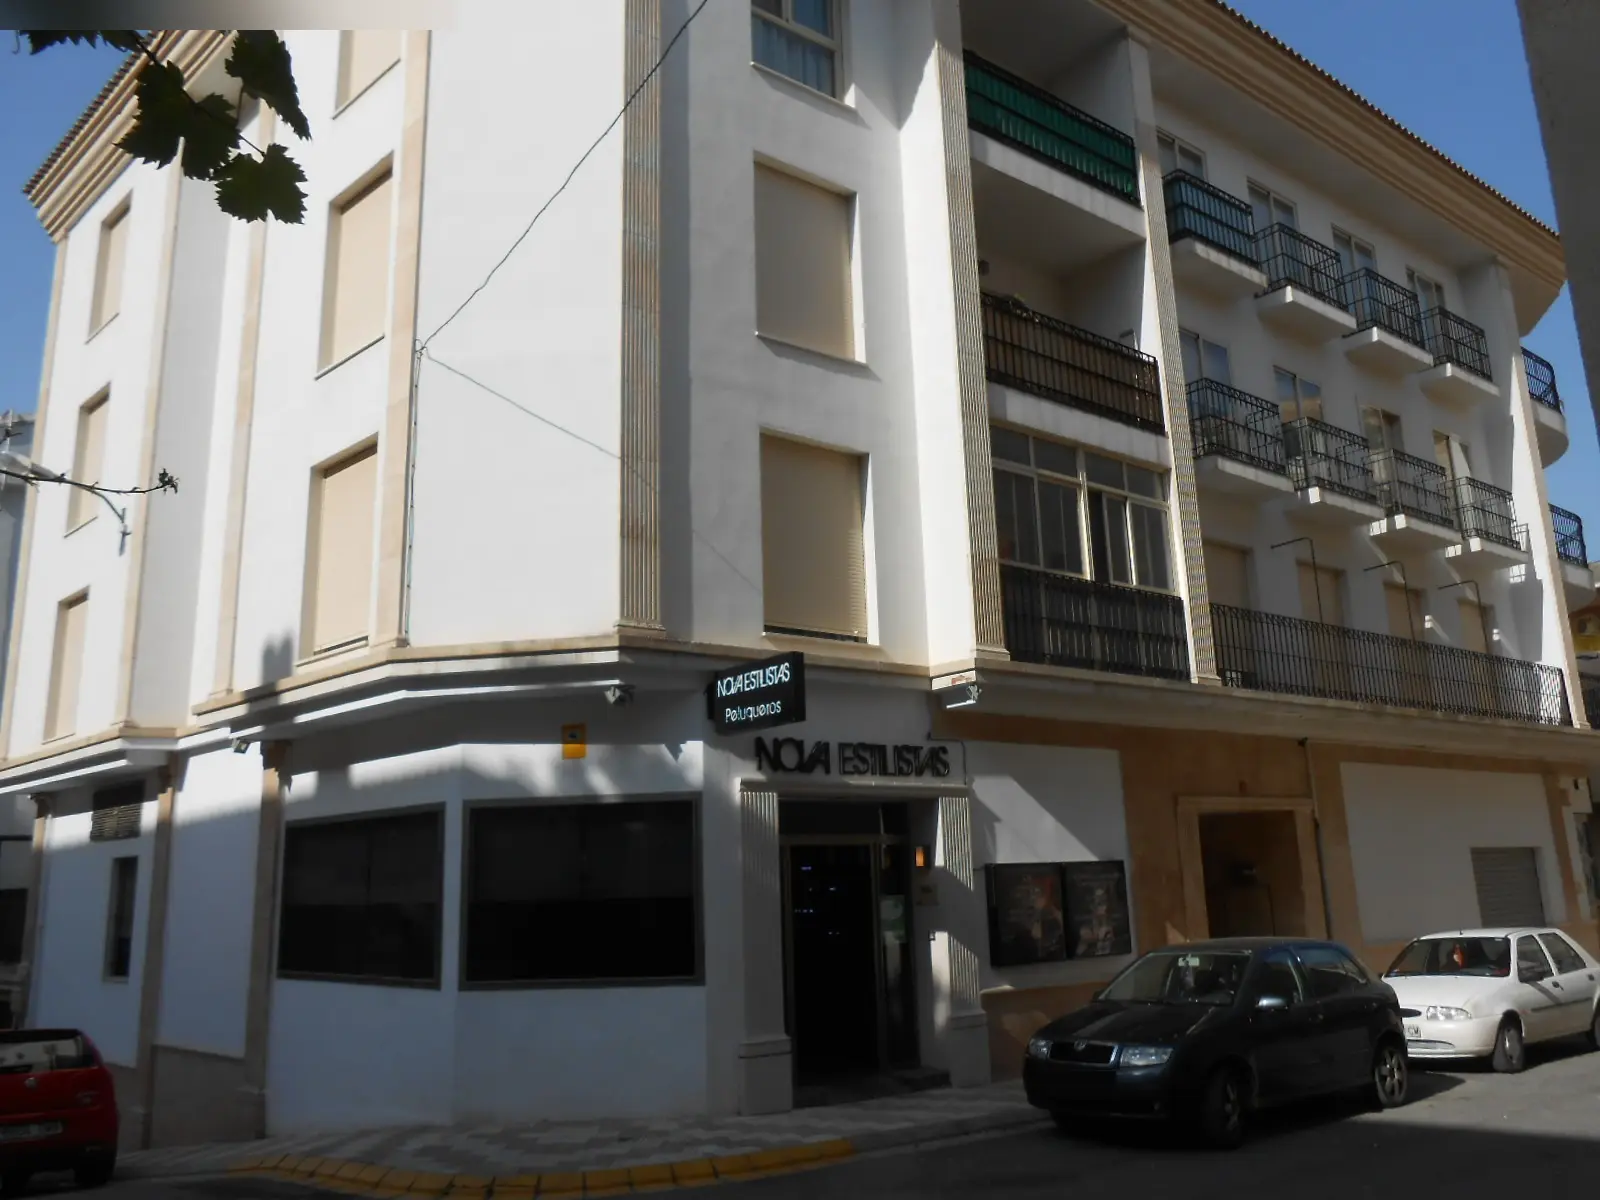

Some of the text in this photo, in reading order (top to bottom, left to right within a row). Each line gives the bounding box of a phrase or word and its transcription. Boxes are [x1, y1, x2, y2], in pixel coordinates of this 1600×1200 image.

[717, 662, 790, 698] NOVA ESTILISTAS
[725, 700, 782, 724] Peluqueros
[754, 736, 950, 777] NOVA ESTILISTAS
